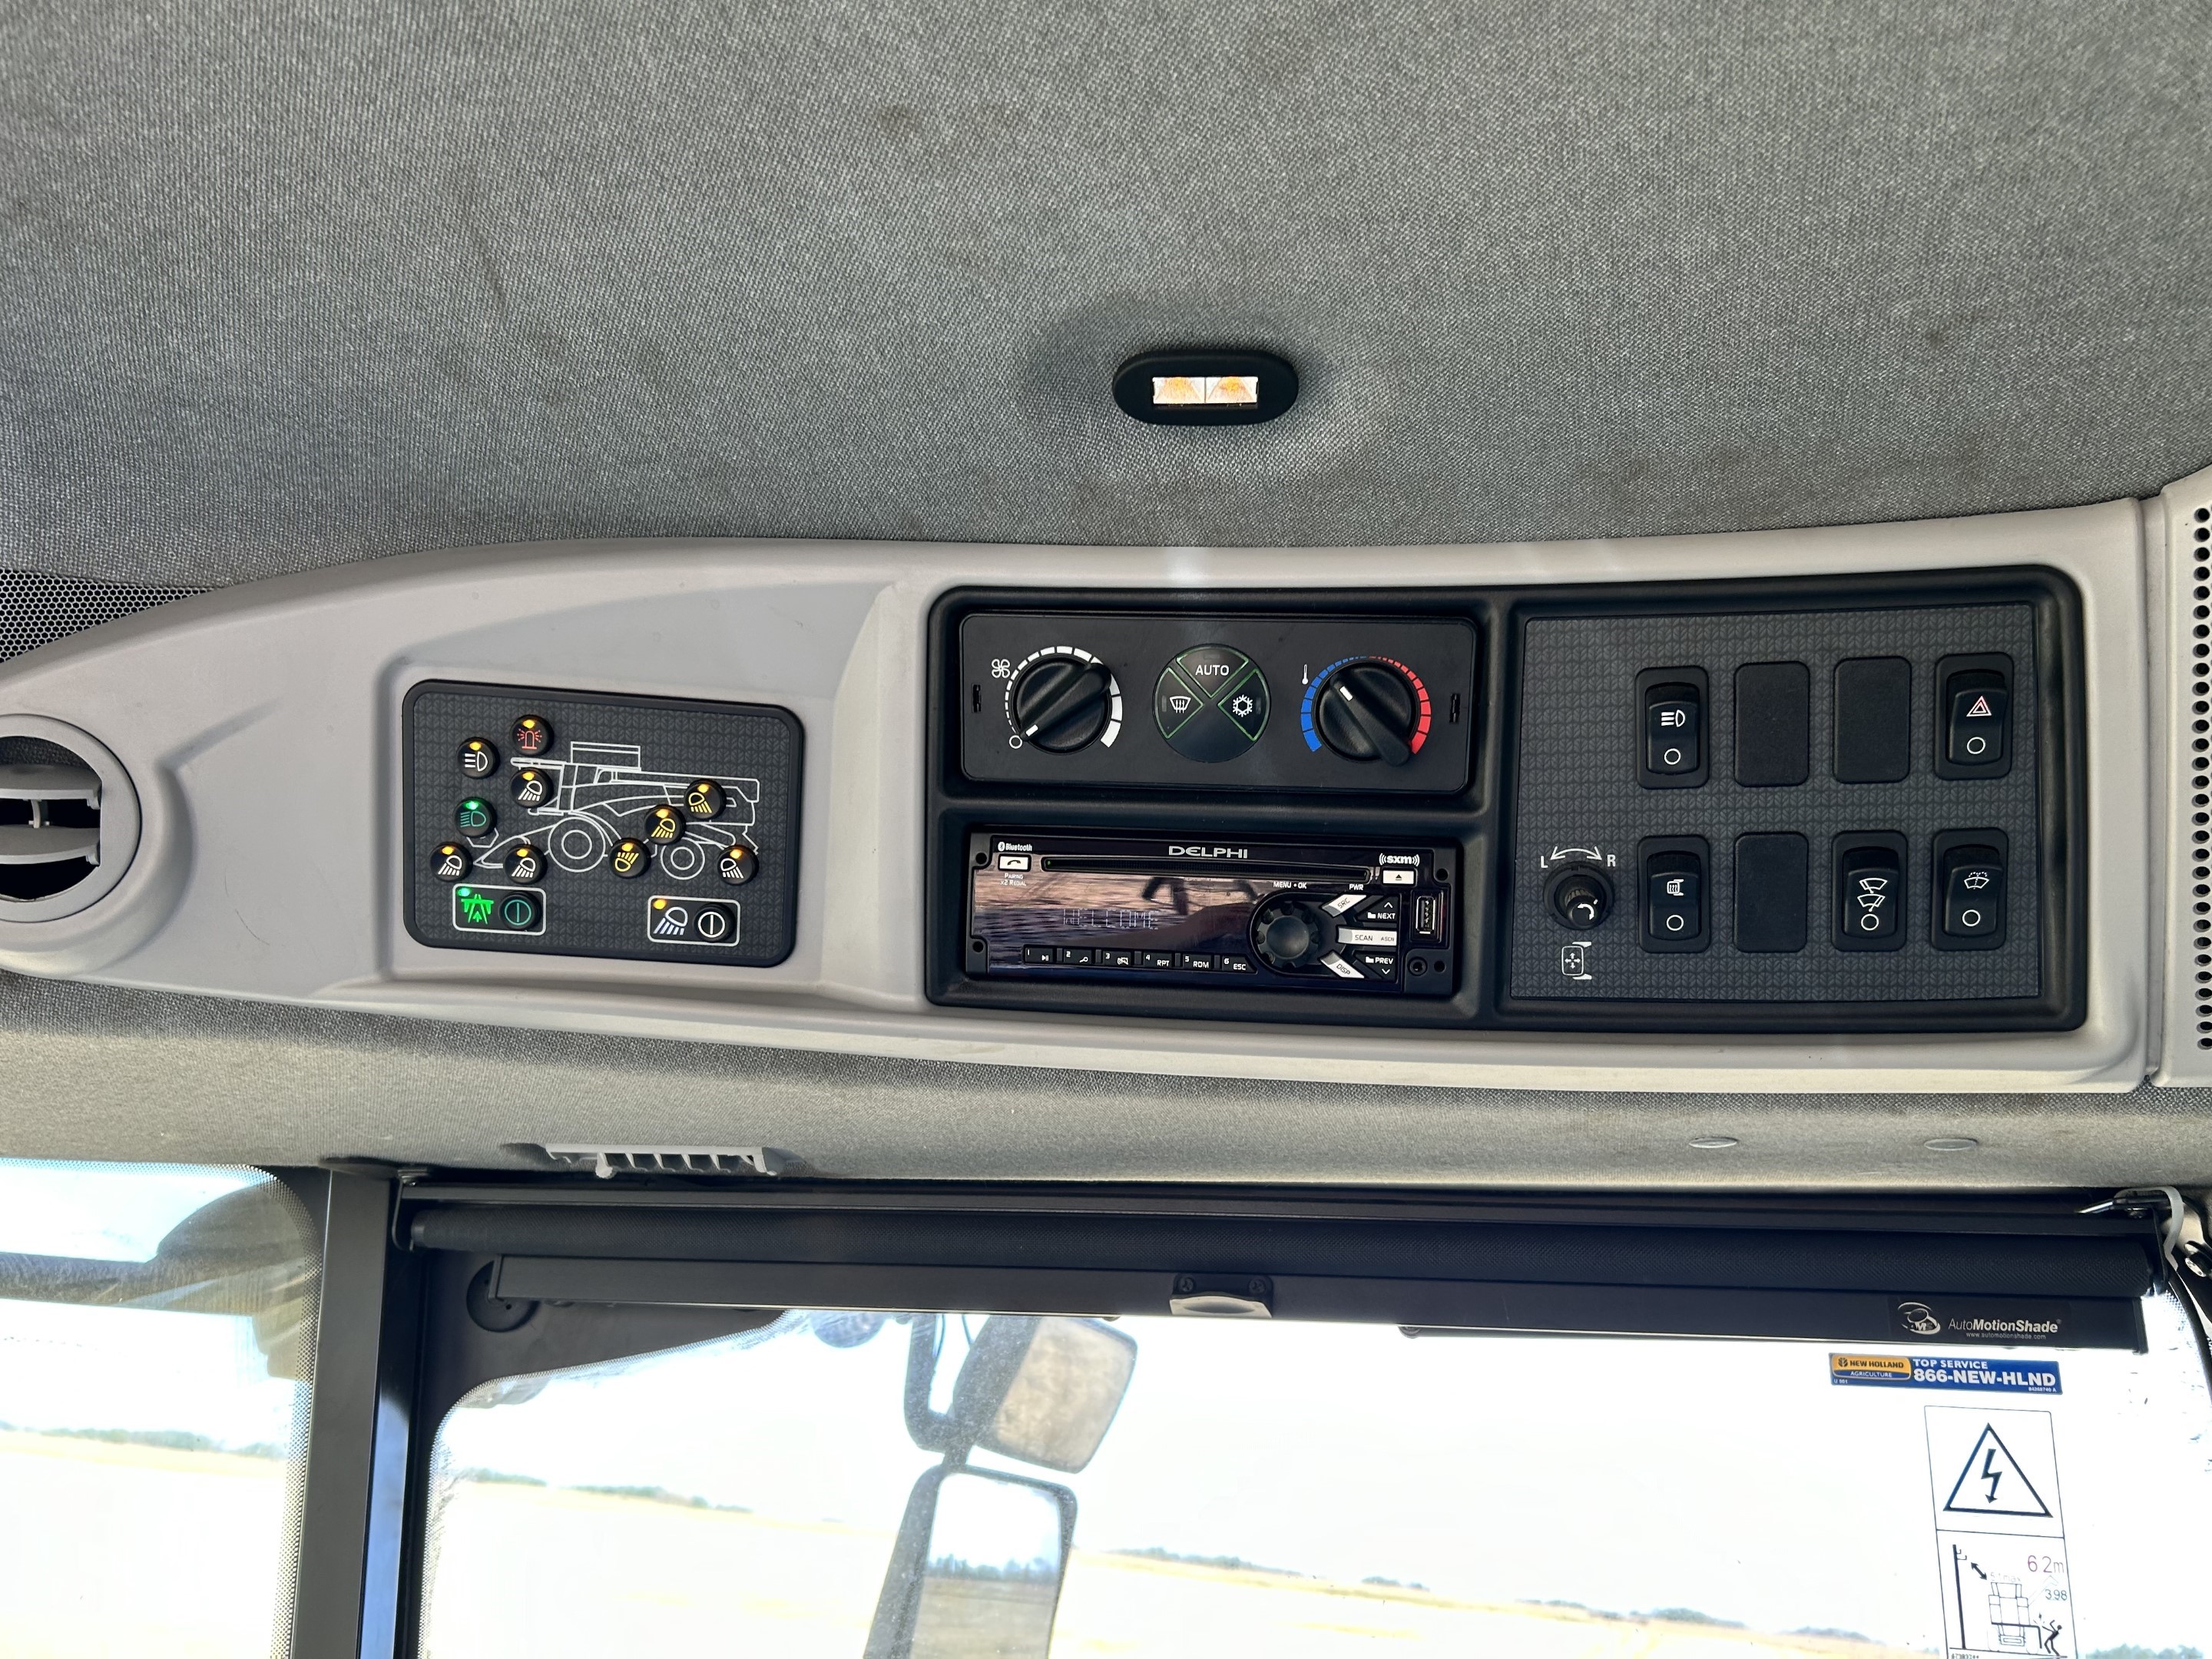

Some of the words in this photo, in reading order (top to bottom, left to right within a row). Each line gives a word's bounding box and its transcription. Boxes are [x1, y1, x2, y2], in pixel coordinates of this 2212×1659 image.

[1195, 664, 1230, 676] AUTO
[1005, 842, 1033, 852] Bluetooth
[1168, 845, 1248, 859] DELPHI
[1540, 855, 1548, 869] L
[1606, 854, 1616, 867] R
[1337, 897, 1350, 909] SRC
[1336, 963, 1351, 975] DISP
[1948, 1317, 2058, 1333] AutoMotionShade
[1965, 1331, 2047, 1340] www.automotionshade.com
[1869, 1360, 1905, 1369] HOLLAND
[1912, 1358, 1938, 1368] TOP
[1940, 1359, 1988, 1369] SERVICE
[1913, 1368, 2056, 1386] 866-NEW-HLND
